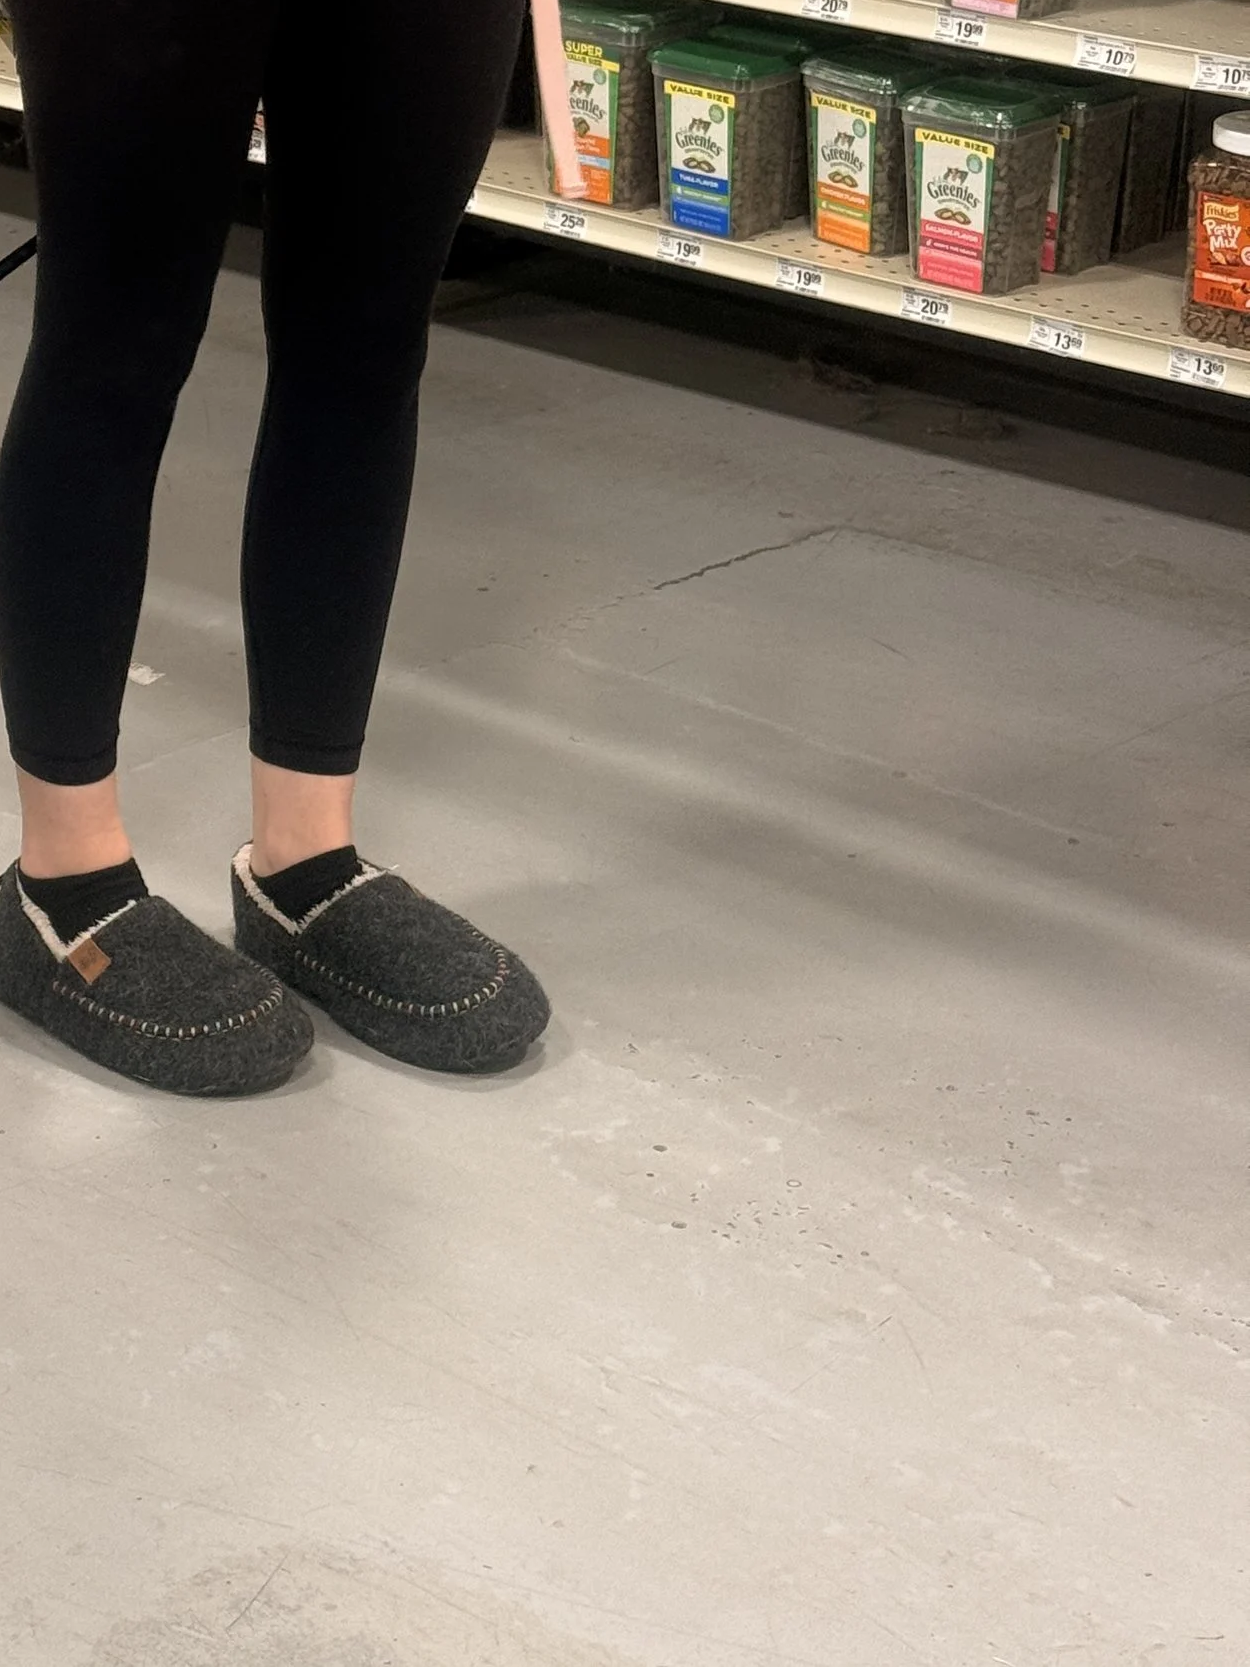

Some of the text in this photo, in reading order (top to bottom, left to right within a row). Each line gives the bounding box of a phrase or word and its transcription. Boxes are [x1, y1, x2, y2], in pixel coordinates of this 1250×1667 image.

[564, 40, 603, 57] SUPER
[670, 83, 731, 103] VALUE SIZE
[815, 95, 871, 119] VALUE SIZE
[675, 131, 723, 159] Greenies
[921, 132, 989, 154] VALUE SIZE
[820, 147, 865, 173] Greenies
[926, 181, 981, 209] Greenies
[1204, 204, 1239, 220] Friskies
[1202, 217, 1242, 238] Party
[1209, 234, 1238, 252] Mix
